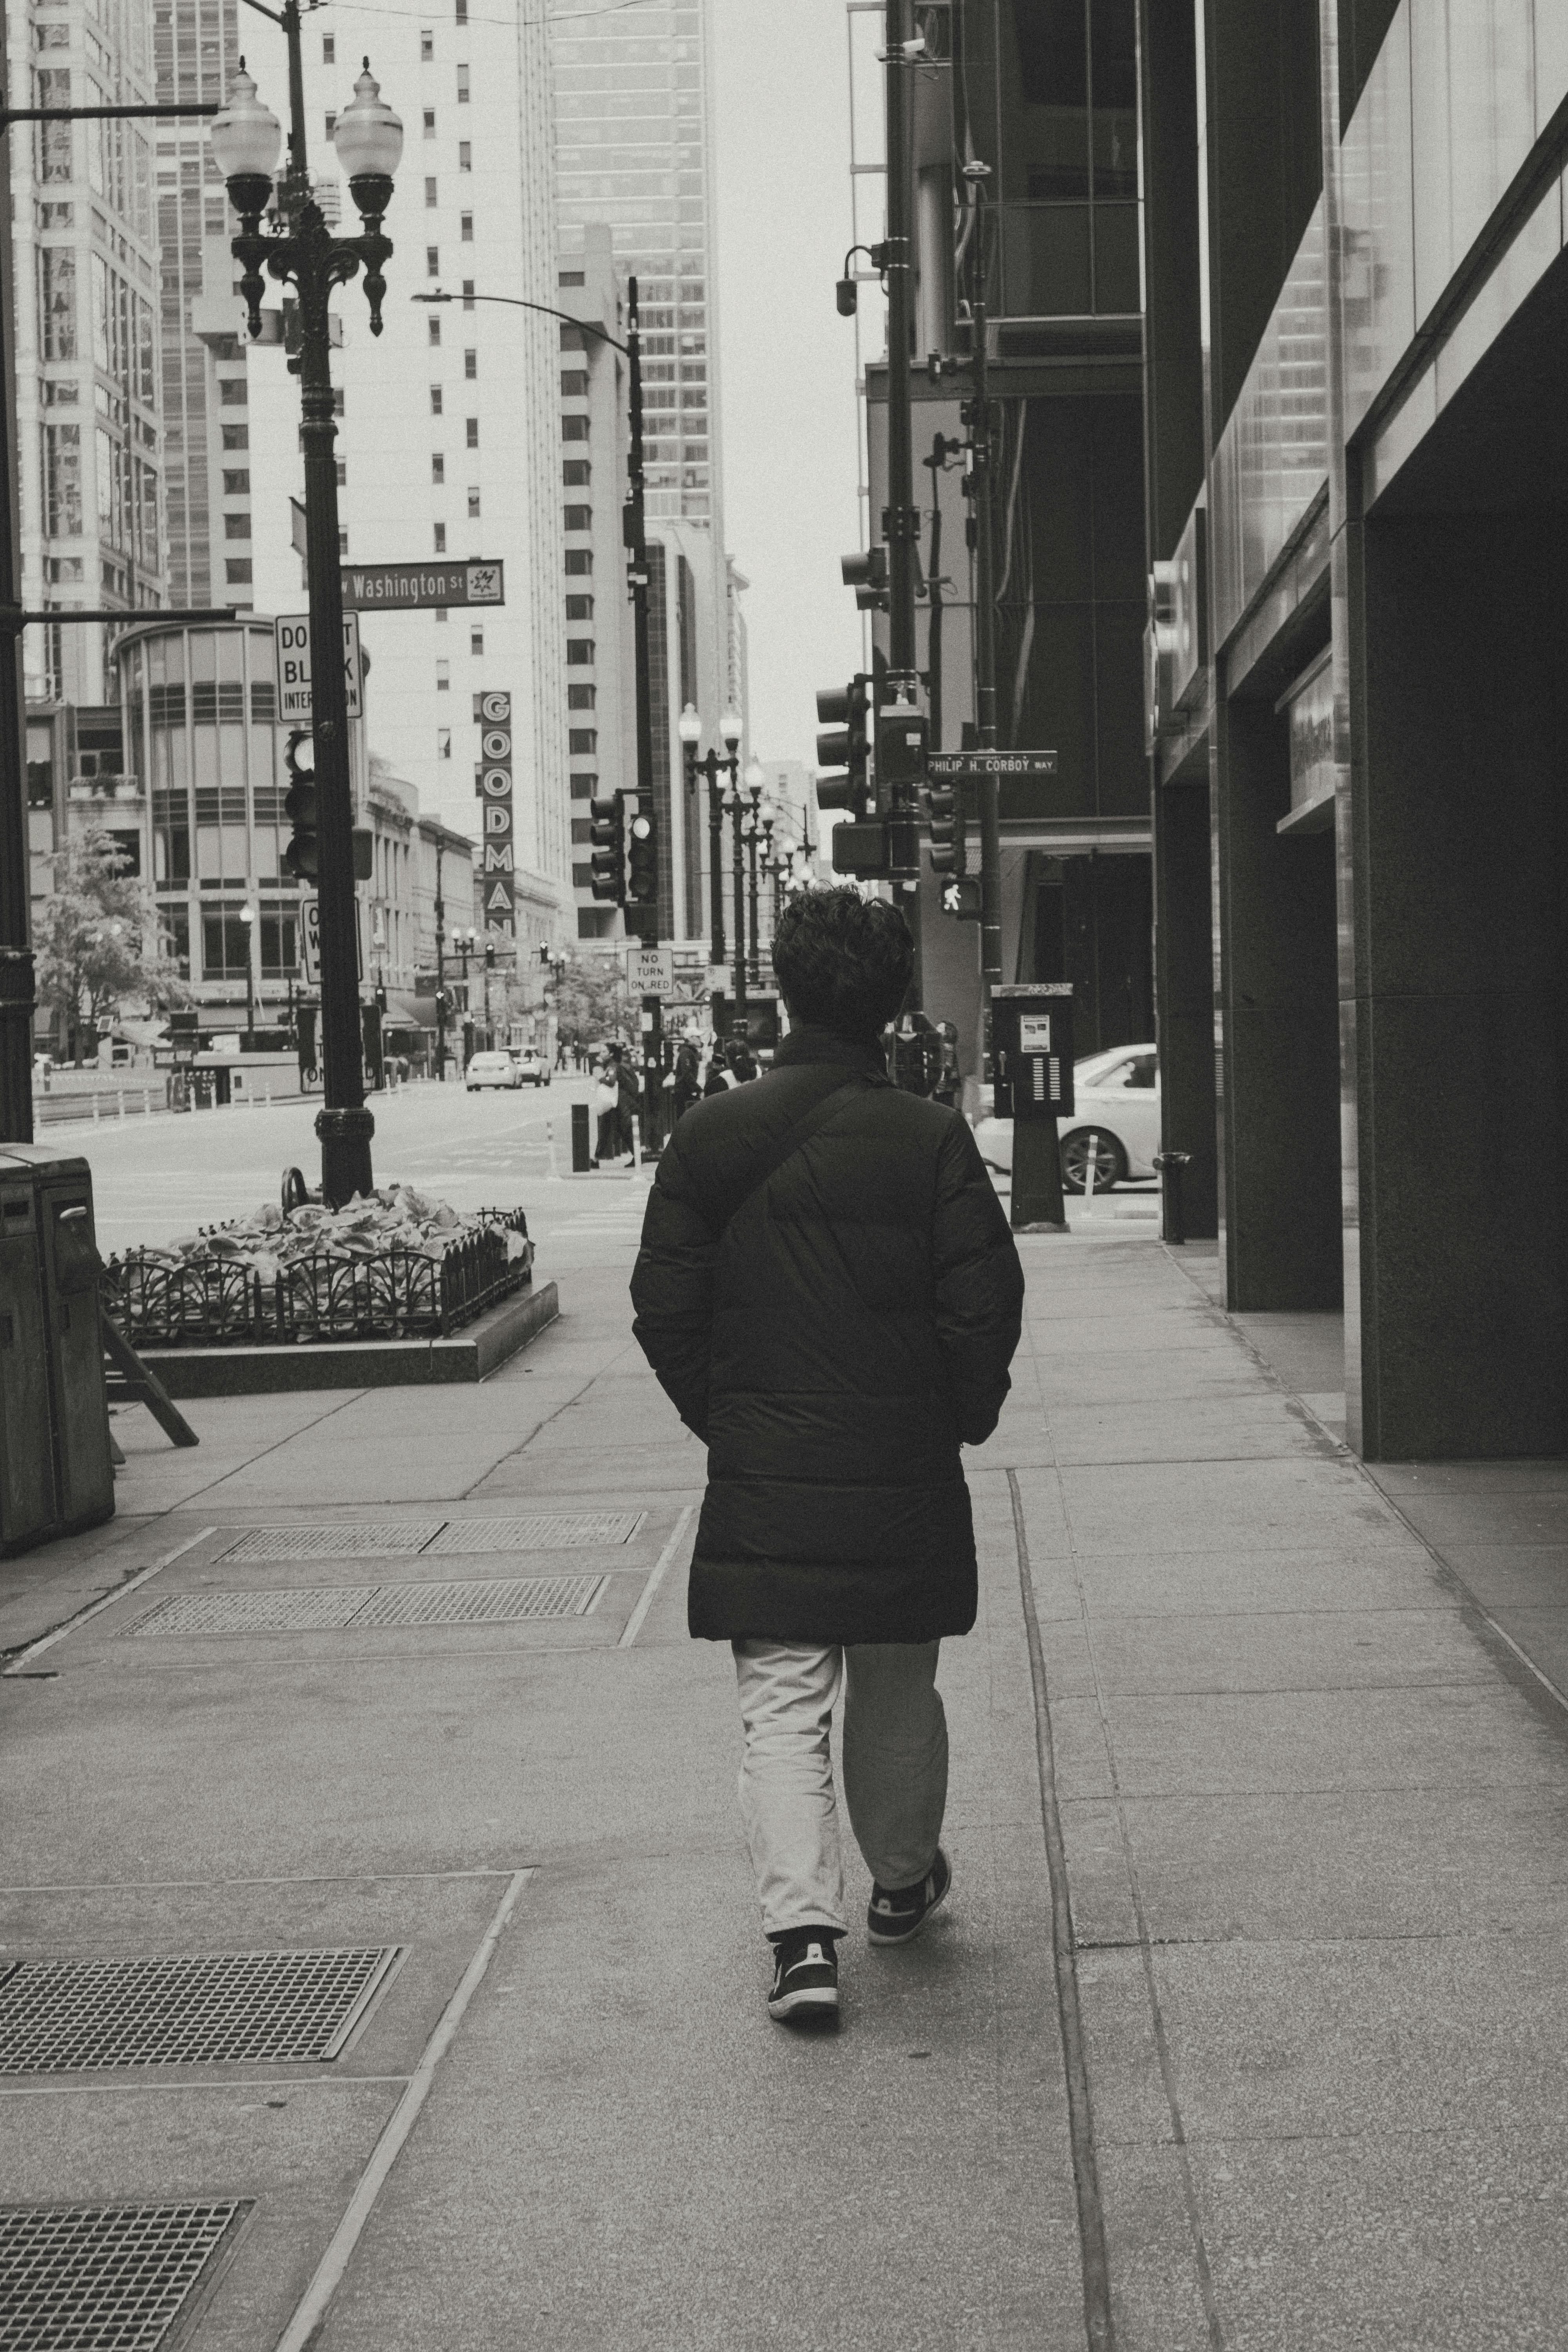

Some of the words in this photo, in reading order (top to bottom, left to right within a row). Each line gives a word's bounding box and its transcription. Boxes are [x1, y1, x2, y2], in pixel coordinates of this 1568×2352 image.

[353, 573, 446, 604] Washington
[451, 576, 462, 588] St
[282, 626, 307, 648] DO
[285, 657, 353, 683] BLK
[928, 760, 963, 772] PHILIP
[969, 760, 981, 771] H.
[985, 760, 1029, 771] CORBOY
[1034, 761, 1053, 769] WAY
[641, 954, 658, 964] NO
[637, 967, 664, 976] TURN
[632, 981, 645, 990] ON
[651, 980, 669, 989] RED
